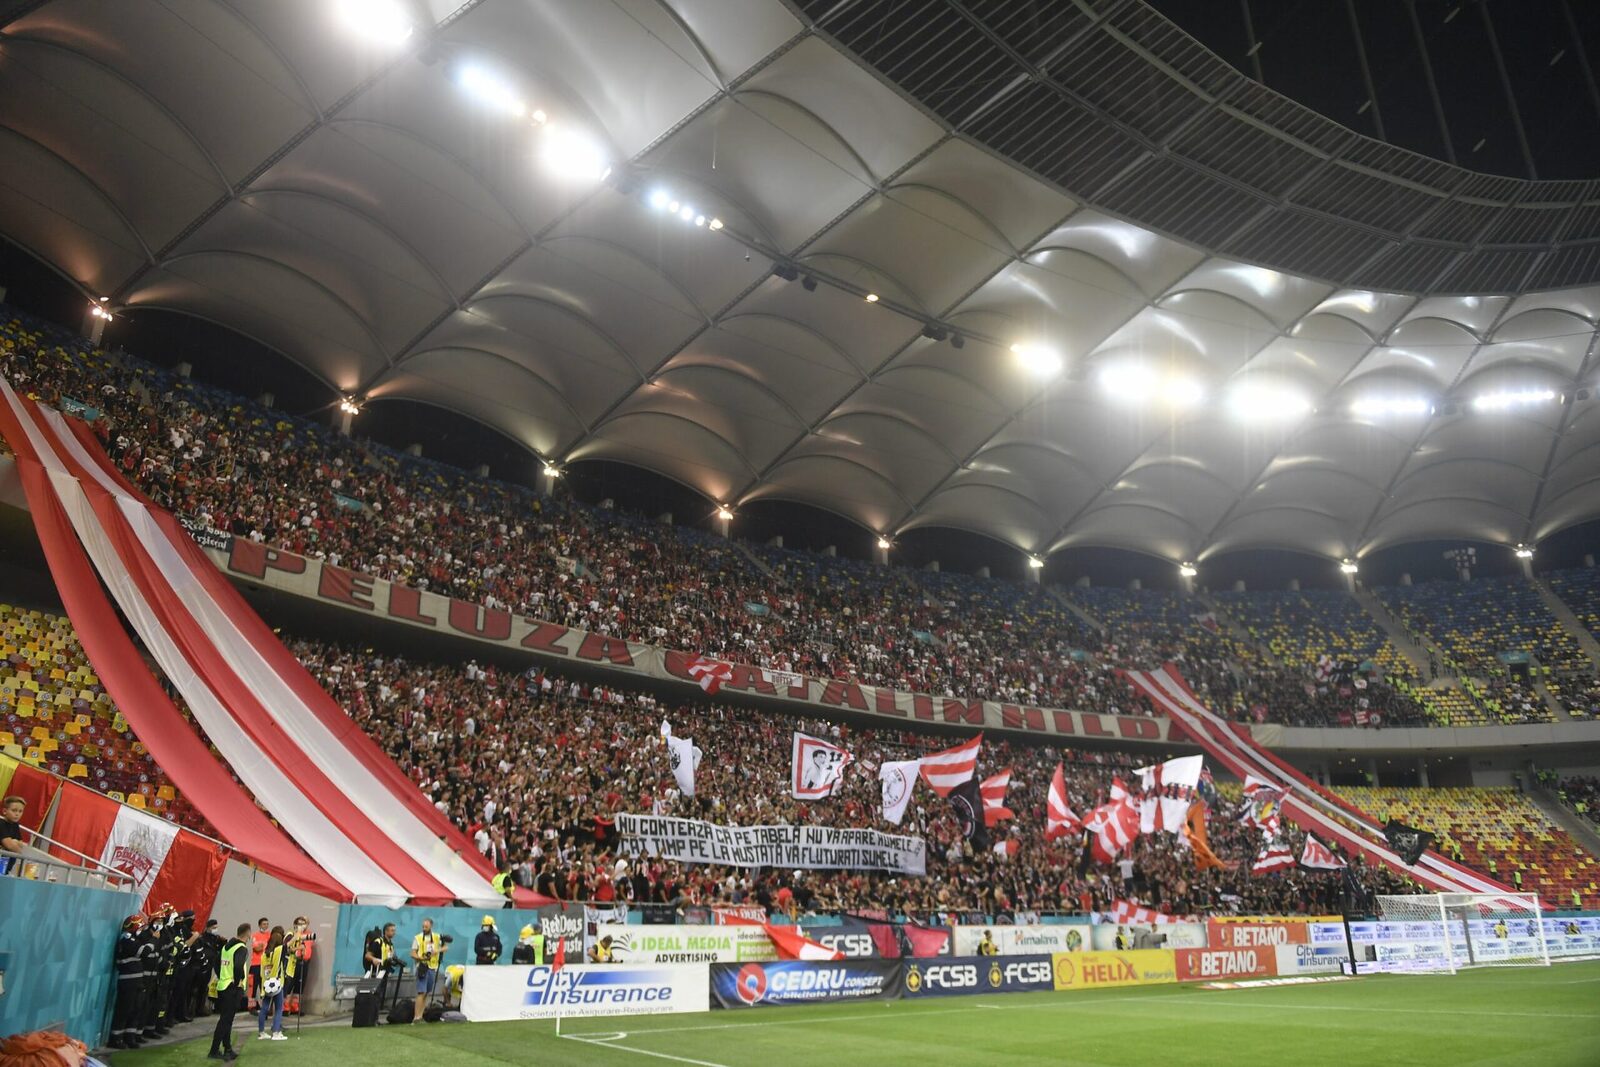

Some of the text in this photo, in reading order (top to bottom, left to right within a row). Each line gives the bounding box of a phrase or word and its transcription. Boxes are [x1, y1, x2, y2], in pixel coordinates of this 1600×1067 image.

[227, 534, 635, 666] PELUZA
[1002, 704, 1202, 743] HILD
[618, 816, 636, 833] NU
[735, 831, 750, 845] PE
[806, 828, 823, 844] NU
[826, 829, 841, 844] VA
[841, 830, 876, 846] APARE
[652, 838, 686, 857] TIMP
[689, 839, 710, 858] PE
[712, 842, 735, 861] LA
[642, 936, 731, 951] IDEAL MEDIA
[1015, 930, 1058, 946] Himalaya
[1234, 926, 1287, 947] BETANO
[655, 952, 718, 964] ADVERTISING
[1296, 945, 1315, 958] City
[1303, 956, 1349, 966] Insurance
[1004, 962, 1051, 984] FCSB
[1083, 964, 1136, 982] HELIX
[1201, 950, 1257, 976] BETANO
[527, 967, 583, 992] City
[771, 969, 884, 991] CEDRU CONCEPT
[924, 965, 977, 988] FCSB
[542, 987, 672, 1005] Insurance
[520, 1009, 562, 1018] Societat
